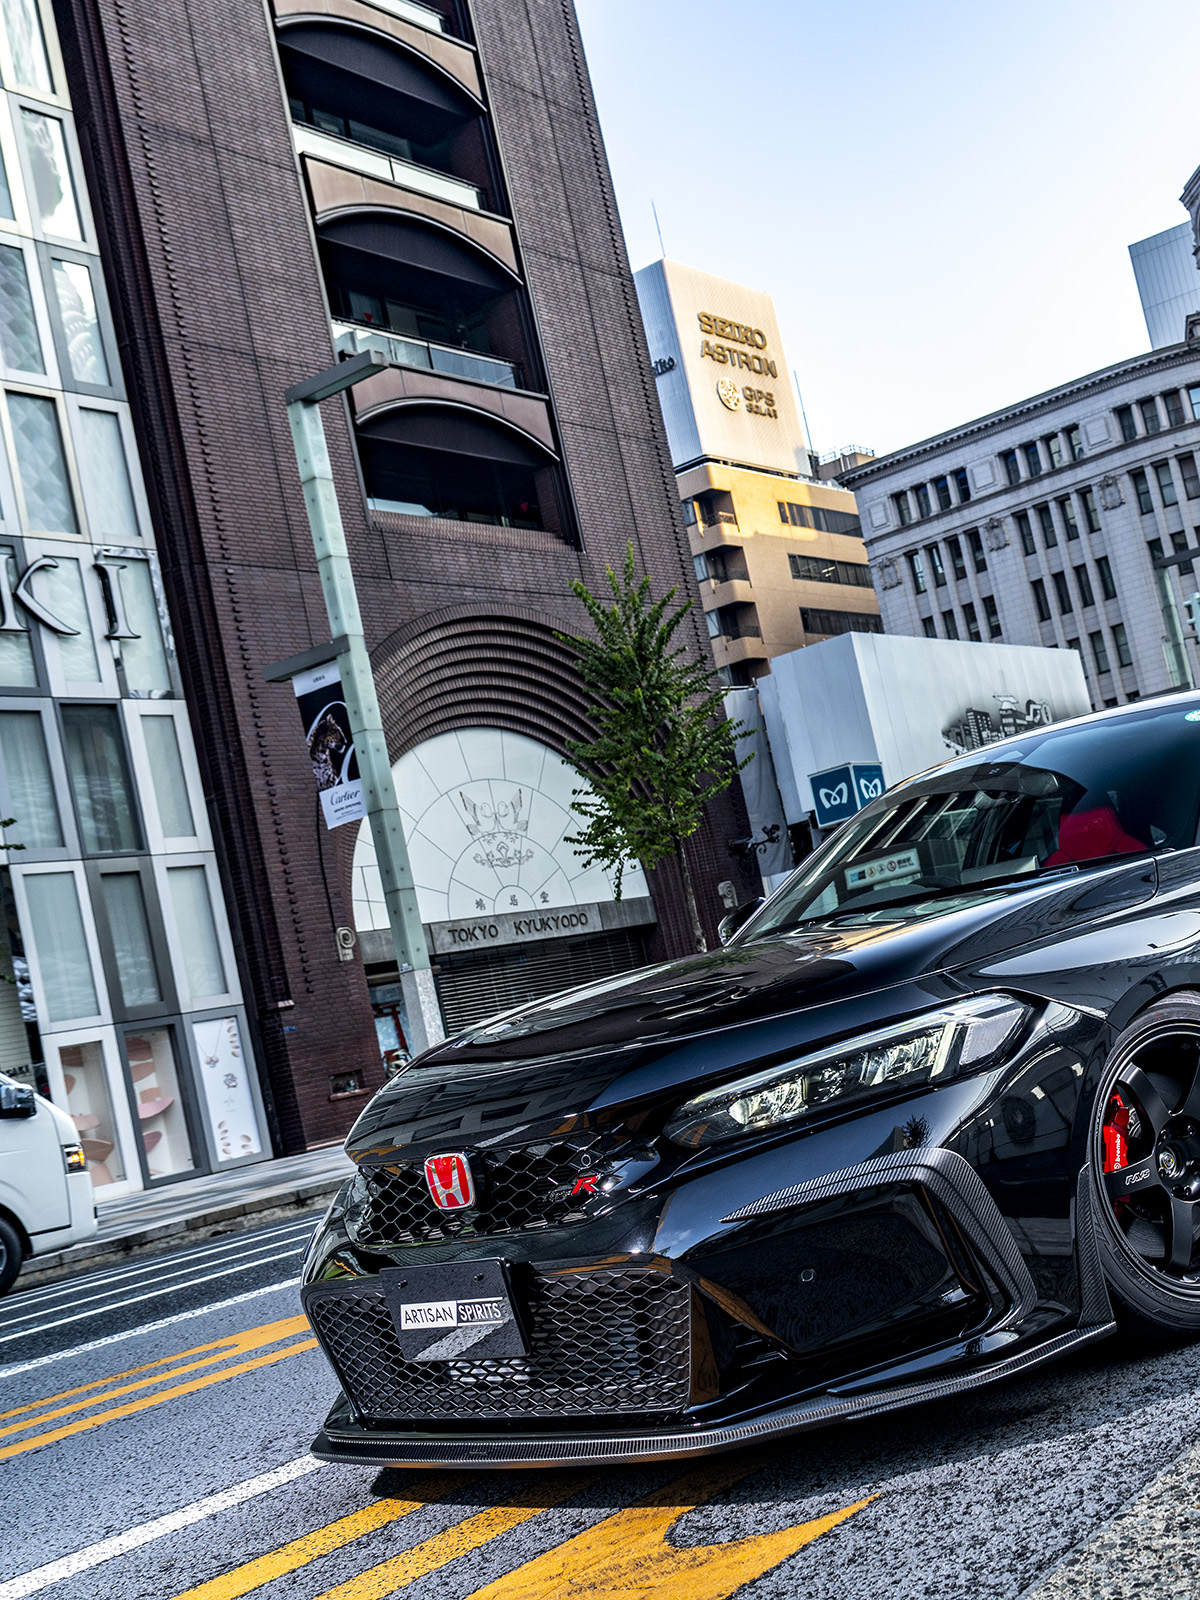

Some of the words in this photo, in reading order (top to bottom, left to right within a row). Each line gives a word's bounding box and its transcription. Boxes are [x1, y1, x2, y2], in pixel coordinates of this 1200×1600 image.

[697, 311, 768, 350] SEIKO
[700, 340, 778, 379] ASTRON
[742, 386, 776, 407] GPS
[330, 790, 361, 806] Cartier
[448, 924, 499, 944] TOKYO
[513, 912, 588, 935] KYUKYODO
[571, 1175, 600, 1195] R
[1125, 1168, 1150, 1185] RAYS
[405, 1306, 454, 1324] ARTISAN
[458, 1302, 502, 1321] SPIRITS
